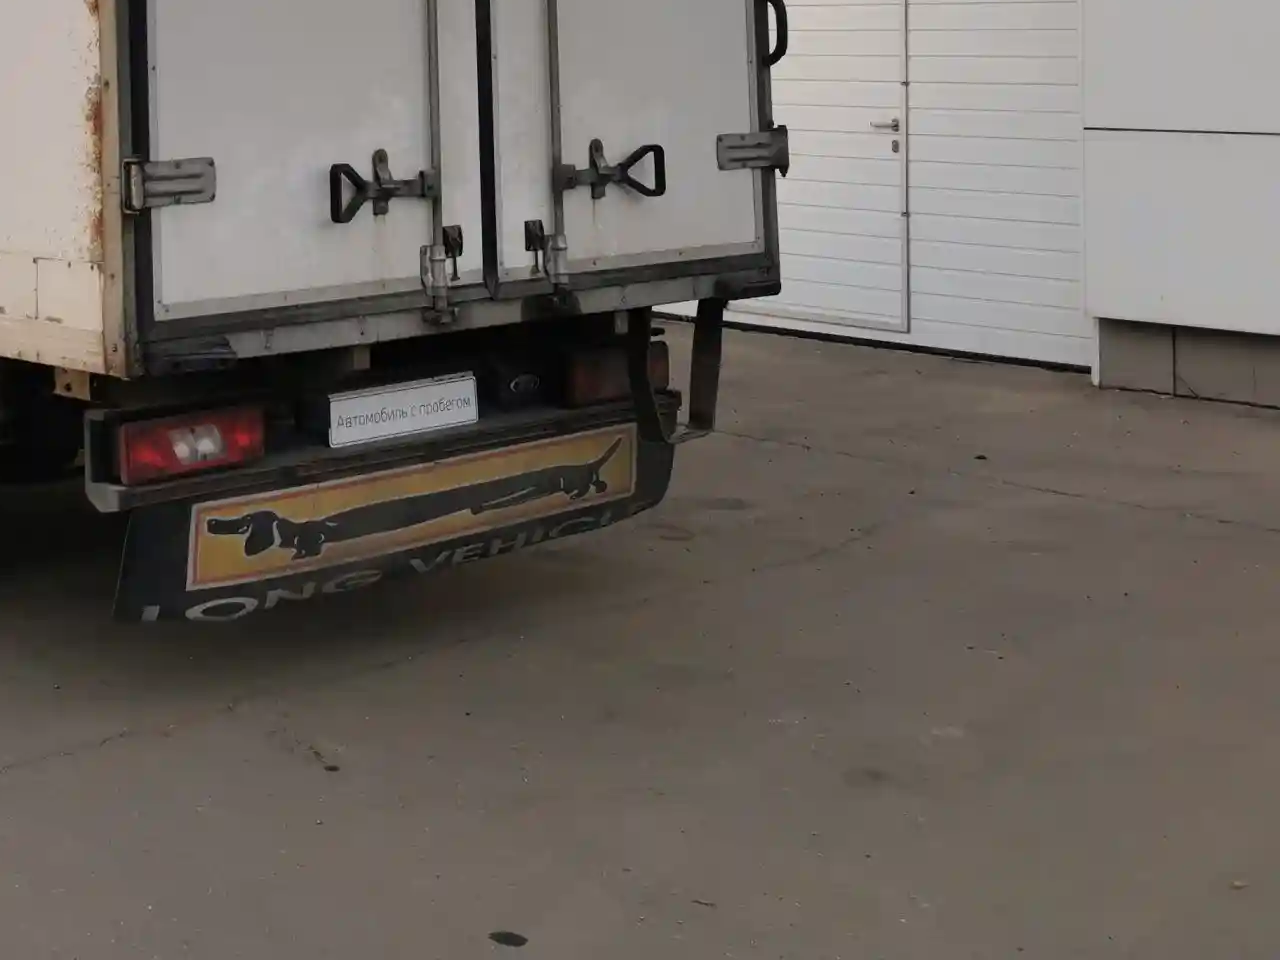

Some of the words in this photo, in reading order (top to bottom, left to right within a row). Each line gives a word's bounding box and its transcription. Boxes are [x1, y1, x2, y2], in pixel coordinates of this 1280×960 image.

[337, 407, 408, 428] Автомобиль
[410, 405, 416, 417] с
[419, 396, 471, 417] пробегом
